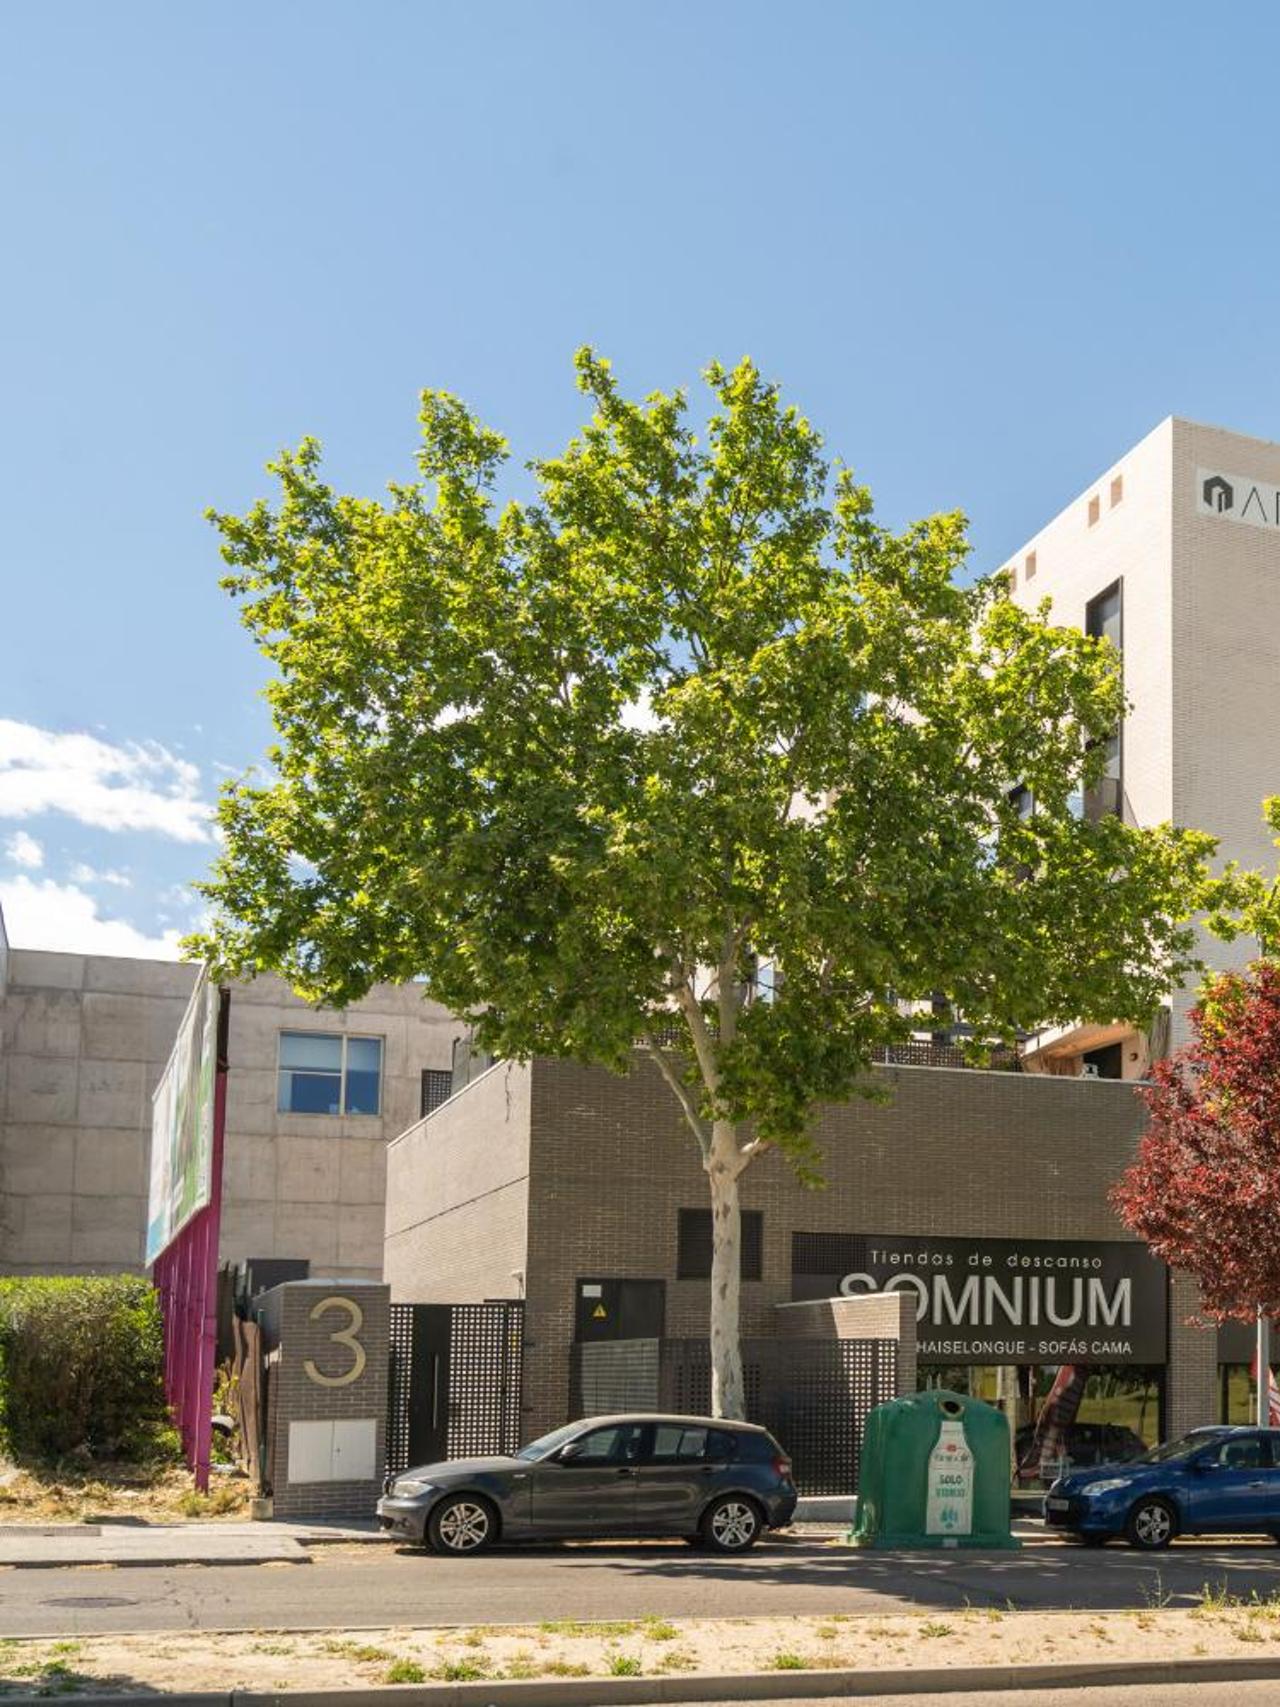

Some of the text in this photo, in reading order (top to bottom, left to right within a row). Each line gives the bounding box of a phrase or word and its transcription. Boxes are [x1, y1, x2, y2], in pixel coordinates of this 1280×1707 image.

[870, 1250, 1102, 1269] Tiendas de descanso
[303, 1296, 366, 1387] 3
[916, 1341, 1025, 1355] HAISELONGUE
[1038, 1338, 1087, 1355] SOFÁS
[1091, 1341, 1132, 1355] CAMA
